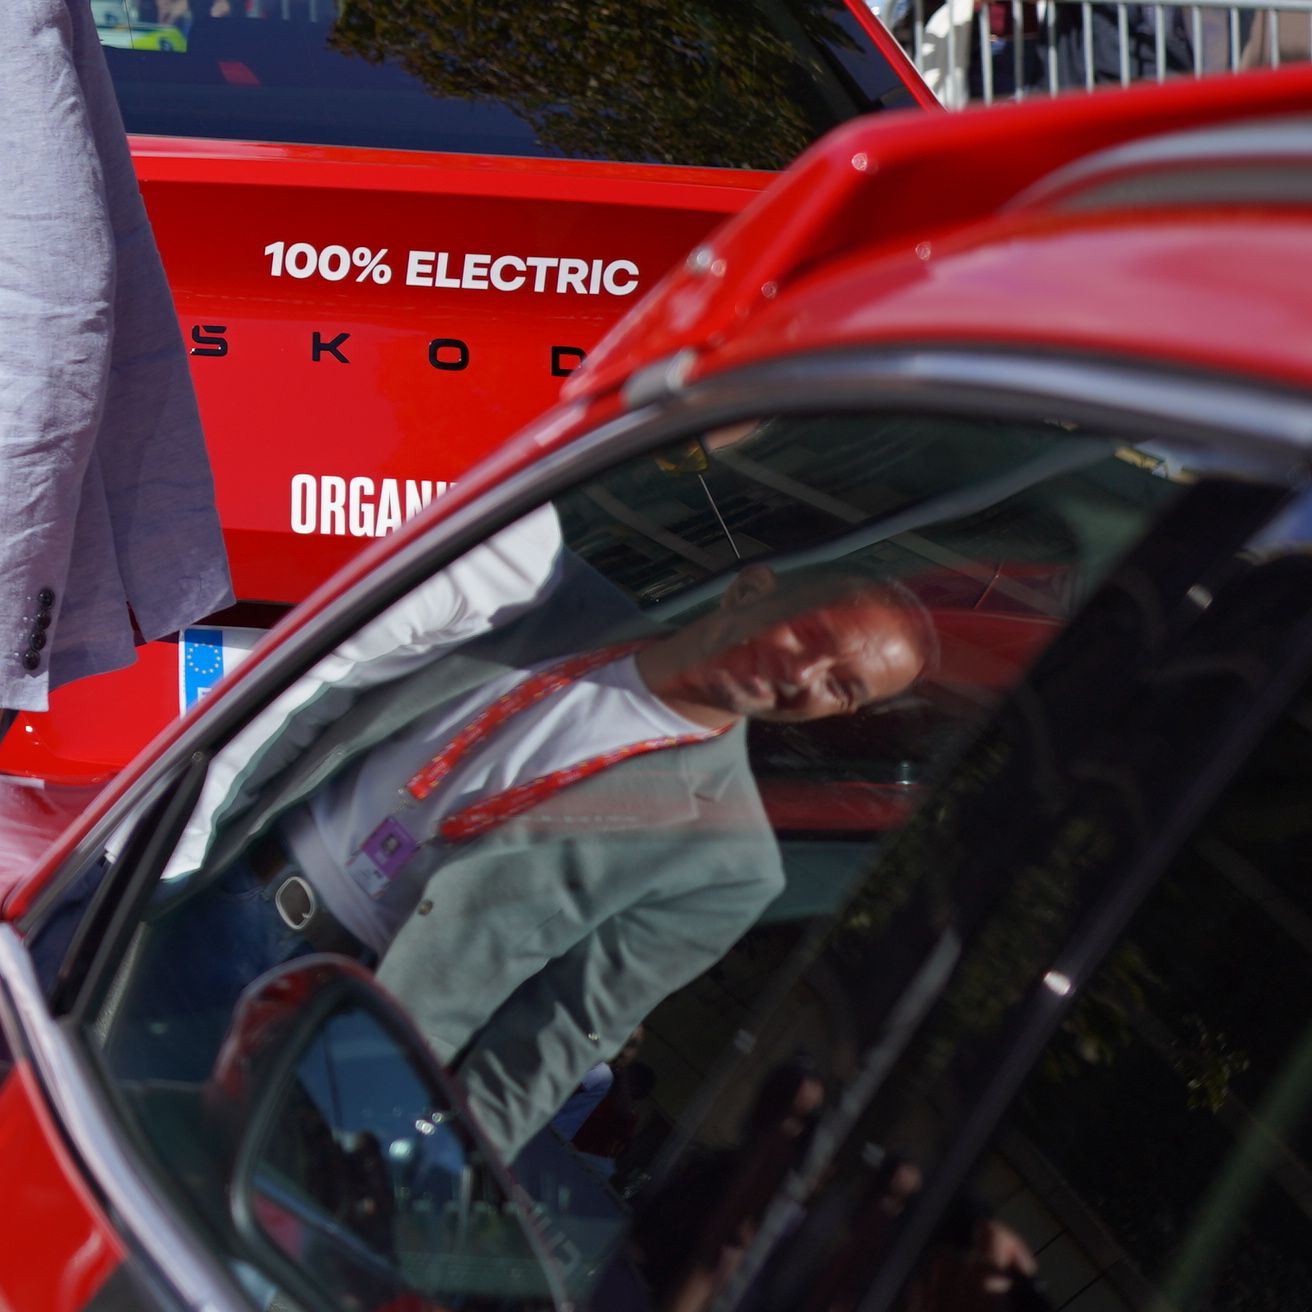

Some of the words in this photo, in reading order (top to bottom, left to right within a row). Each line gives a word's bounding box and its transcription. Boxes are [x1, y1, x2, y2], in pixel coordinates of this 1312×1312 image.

[264, 241, 392, 285] 100%
[405, 250, 640, 296] ELECTRIC
[290, 473, 459, 537] ORGAN
